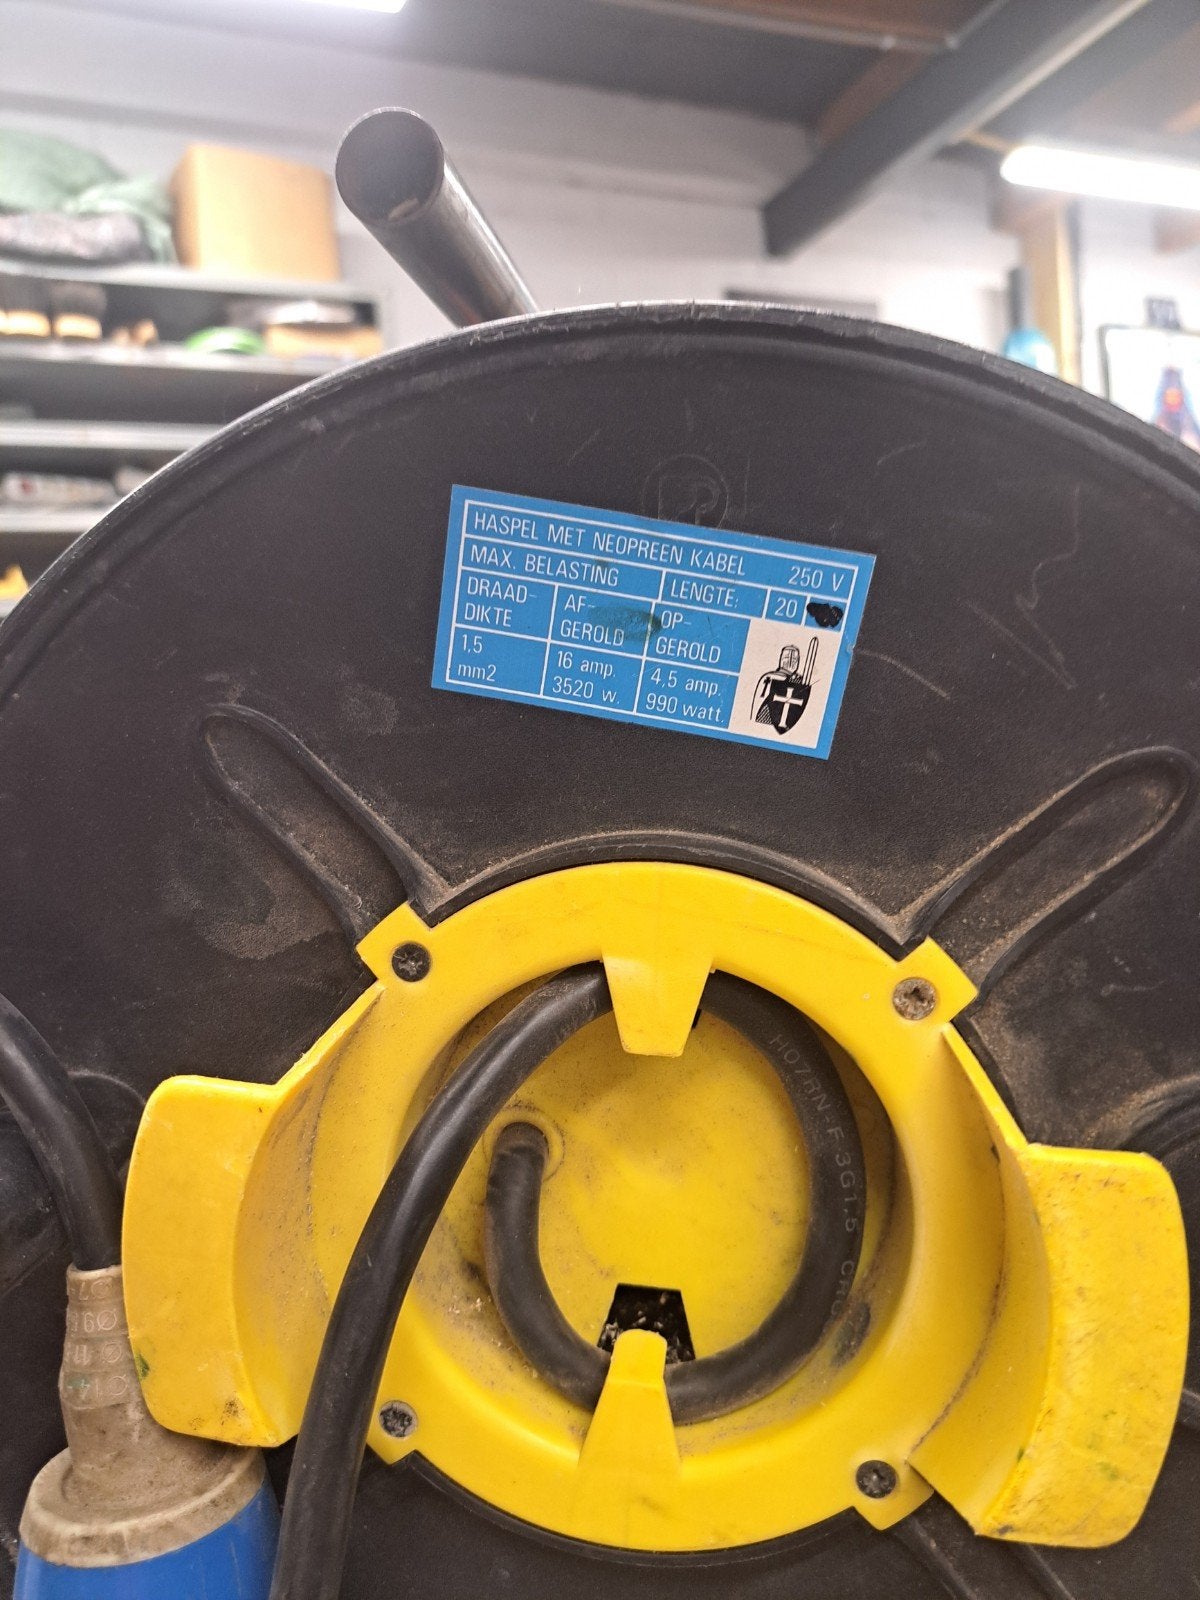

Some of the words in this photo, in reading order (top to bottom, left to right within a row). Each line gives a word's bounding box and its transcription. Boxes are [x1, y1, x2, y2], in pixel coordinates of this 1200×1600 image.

[474, 511, 538, 540] HASPEL
[547, 523, 586, 547] MET
[592, 532, 683, 565] NEOPREEN
[690, 548, 745, 576] KABEL
[788, 566, 823, 589] 250
[832, 572, 844, 592] V
[470, 545, 516, 570] MAX.
[525, 554, 619, 587] BELASTING
[467, 576, 537, 604] DRAAD-
[564, 593, 596, 613] AF-
[670, 579, 739, 608] LENGTE:
[774, 597, 798, 618] 20
[464, 603, 513, 628] DIKTE
[661, 610, 692, 630] OP-
[461, 634, 483, 654] 1,5
[560, 619, 625, 647] GEROLD
[655, 636, 721, 664] GEROLD
[457, 664, 497, 682] mm2
[557, 650, 573, 669] 16
[580, 659, 616, 679] amp.
[552, 676, 594, 699] 3520
[602, 689, 620, 704] w.
[651, 668, 678, 688] 4,5
[685, 678, 722, 697] amp.
[645, 693, 678, 715] 990
[682, 702, 725, 723] watt.
